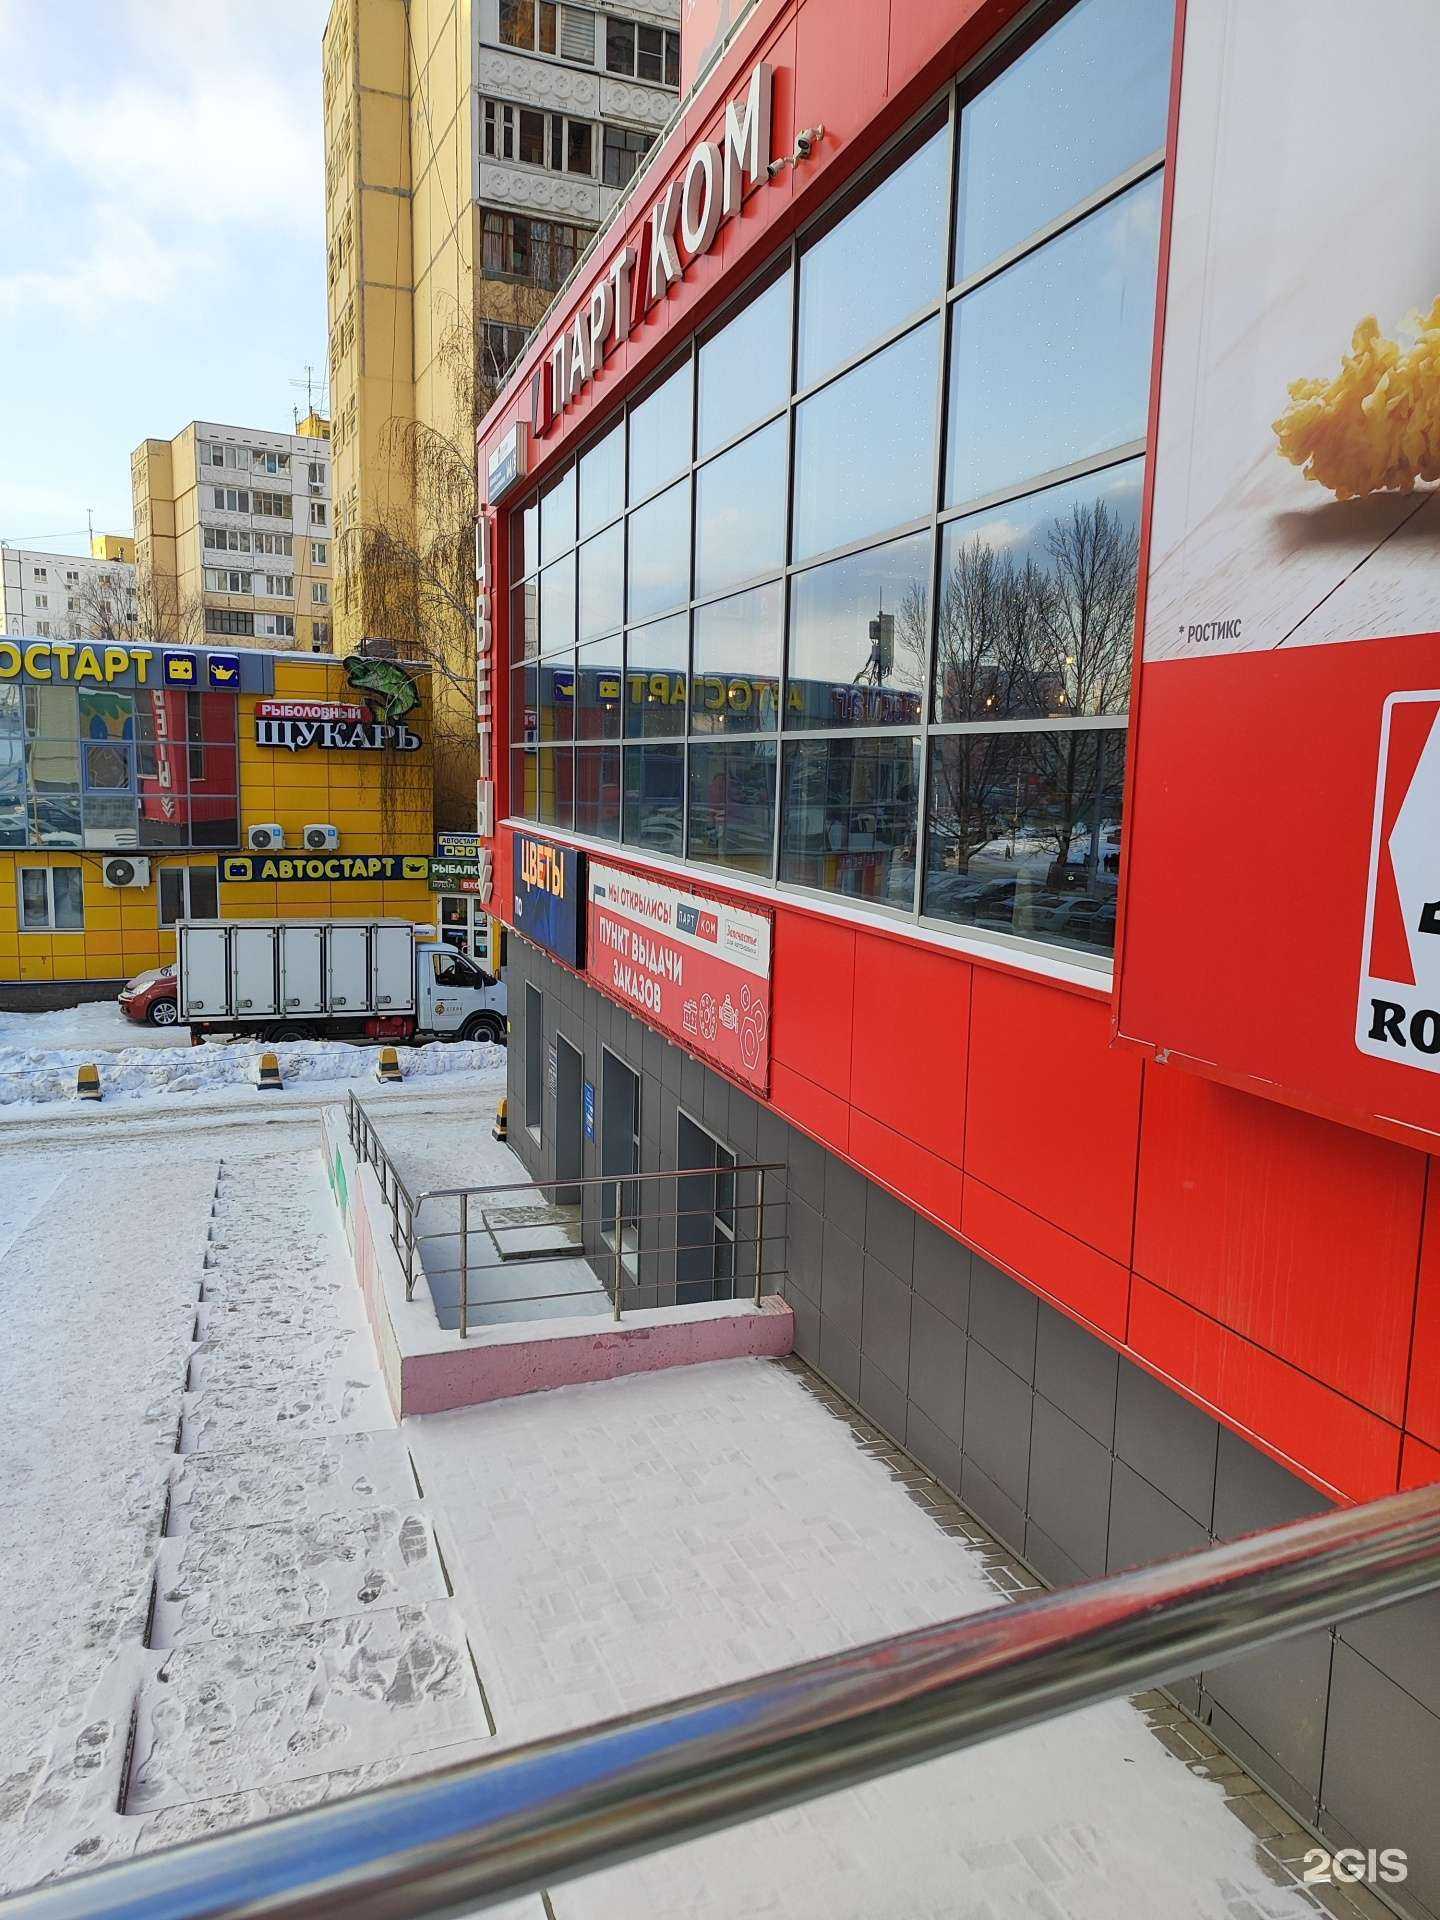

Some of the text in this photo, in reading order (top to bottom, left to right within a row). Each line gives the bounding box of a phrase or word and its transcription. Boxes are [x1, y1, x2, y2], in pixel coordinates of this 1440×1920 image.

[553, 61, 773, 415] ПАРТ КОМ
[1187, 618, 1242, 644] РОСТИКС
[262, 704, 362, 720] РЫБОЛОВНЫЙ
[256, 720, 421, 752] ЩУКАРЬ
[441, 838, 479, 846] АВТОСТАРТ
[261, 858, 396, 879] АВТОСТАРТ
[521, 838, 564, 899] ЦВЕТЫ
[608, 882, 673, 926] МЫ ОТКРЫЛИСЬ!
[678, 911, 717, 935] ПАРТ КОМ
[599, 916, 683, 987] ПУНКТ ВЫДАЧИ
[613, 958, 661, 1014] ЗАКАЗОВ
[1367, 998, 1440, 1055] RO
